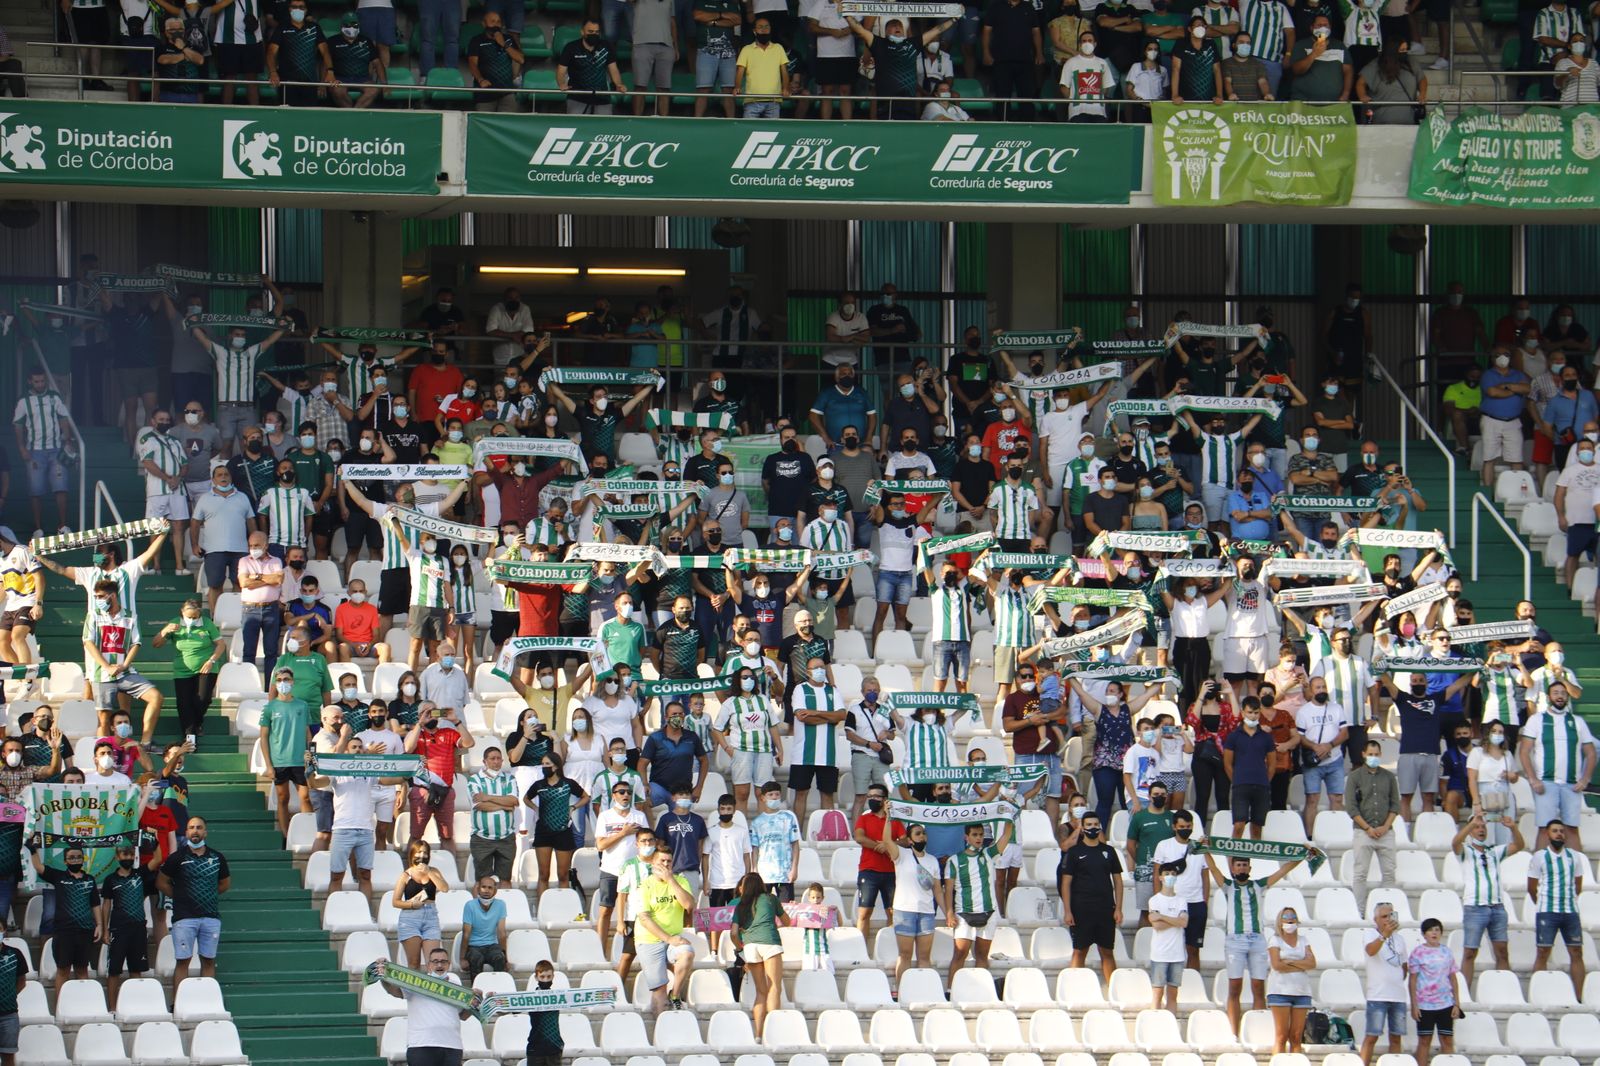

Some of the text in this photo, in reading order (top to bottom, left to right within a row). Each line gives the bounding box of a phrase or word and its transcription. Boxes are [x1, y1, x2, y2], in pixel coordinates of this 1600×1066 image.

[1233, 110, 1265, 124] PEÑA
[57, 128, 173, 151] Diputación
[594, 134, 631, 142] GRUPO
[796, 137, 832, 146] GRUPO
[995, 140, 1032, 148] GRUPO
[293, 135, 406, 157] Diputación
[1525, 140, 1562, 160] TRUPE
[57, 150, 174, 171] de Córdoba
[576, 141, 680, 168] PACC
[777, 144, 880, 171] PACC
[977, 148, 1079, 173] PACC
[293, 156, 406, 177] de Córdoba
[1565, 162, 1589, 175] bien
[527, 170, 654, 187] Correduría de Seguros
[730, 173, 855, 190] Correduría de Seguros
[929, 176, 1053, 191] Correduría de Seguros
[1509, 196, 1528, 207] por
[1535, 196, 1551, 204] mis
[1554, 194, 1596, 204] colores
[200, 313, 233, 322] FORZA
[997, 334, 1073, 346] CÓRDOBA CF
[346, 465, 462, 479] Sentimiento Blanquiverde
[1292, 495, 1375, 507] CÓRDOBA CF
[406, 513, 464, 538] CÓRDOBA
[1116, 531, 1182, 549] CÓRDOBA
[1367, 531, 1435, 544] CÓRDOBA
[509, 565, 588, 580] CÓRDOBA CF
[1167, 560, 1233, 573] CÓRDOA
[579, 639, 597, 649] CF
[1052, 629, 1113, 651] CÓRDOBA
[1086, 661, 1158, 678] CÓRDOBA
[652, 681, 722, 694] CÓRDOBA
[340, 760, 398, 771] CÓRDOBA
[922, 807, 988, 819] CÓRDOBA
[1216, 837, 1304, 857] CÓRDOBA CF
[573, 991, 594, 1003] C.F.
